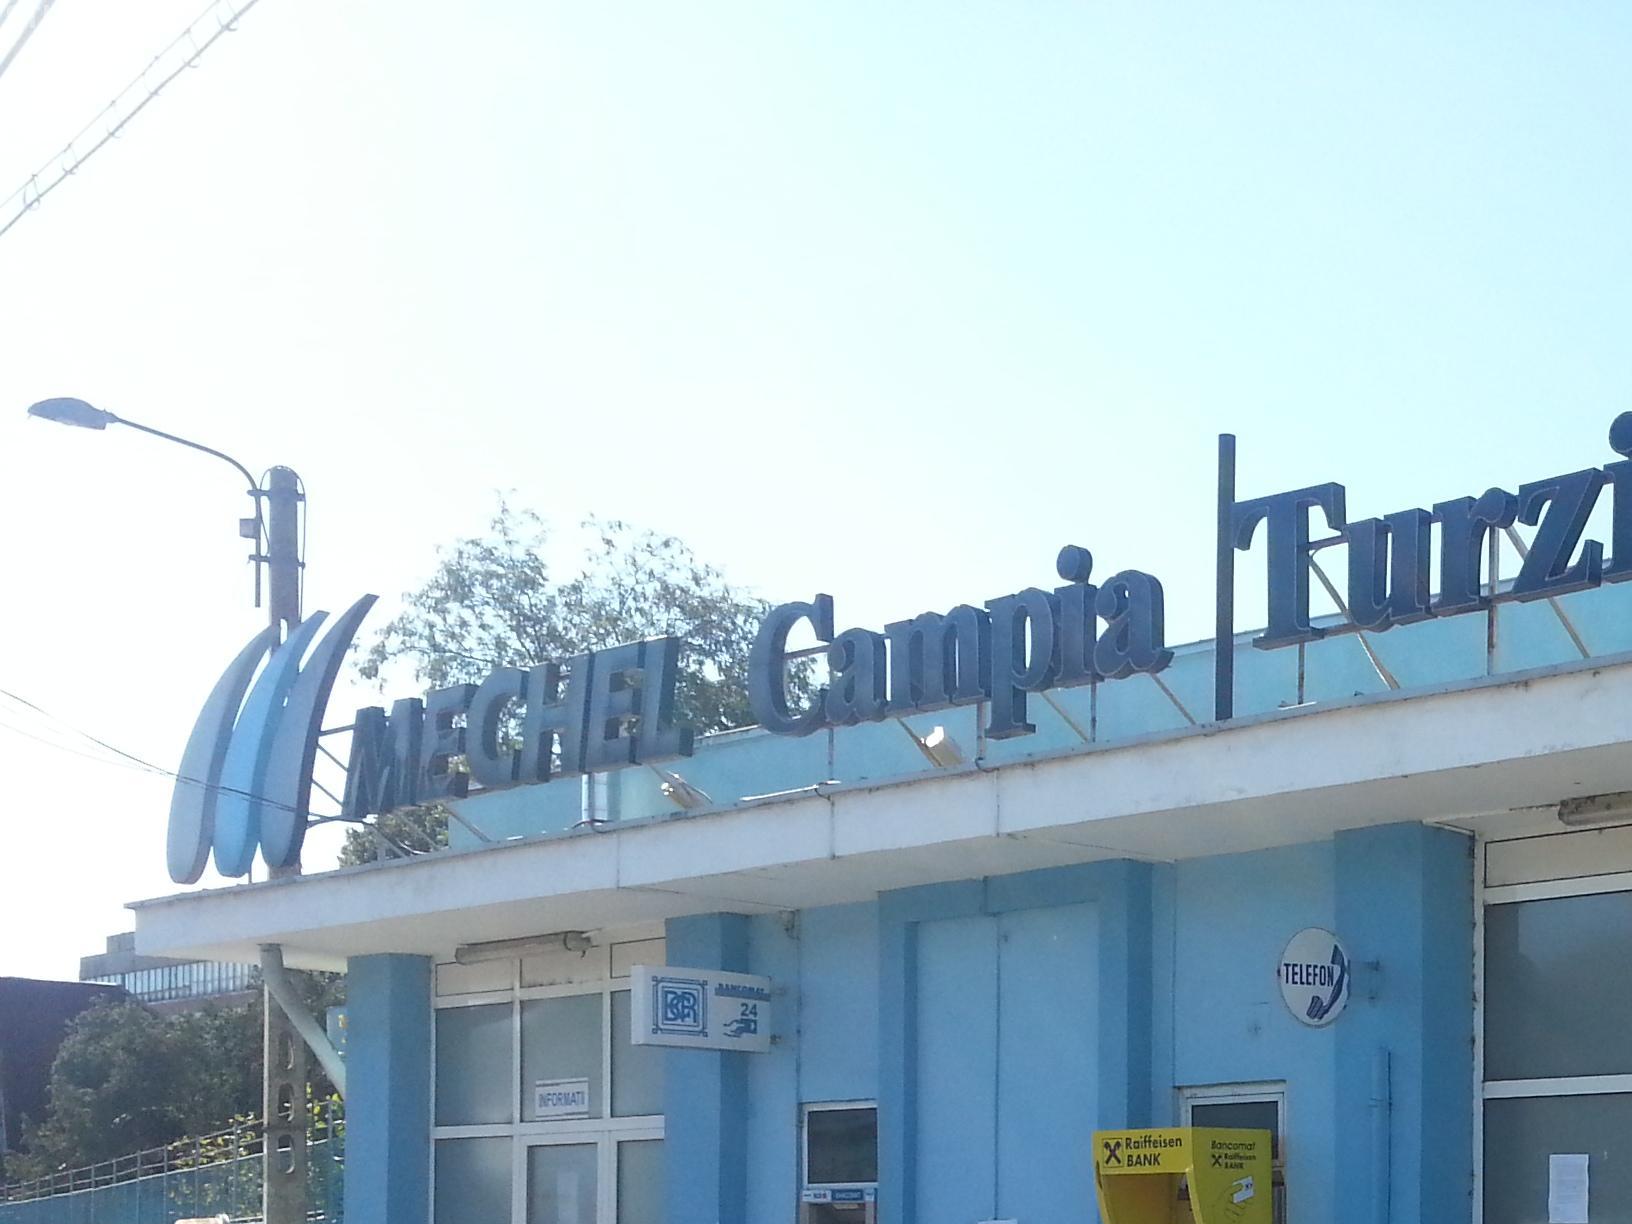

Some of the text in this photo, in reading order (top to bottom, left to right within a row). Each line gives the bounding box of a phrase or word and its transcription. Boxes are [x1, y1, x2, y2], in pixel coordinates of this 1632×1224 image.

[340, 634, 695, 818] MECHEL
[748, 544, 1176, 740] Campia
[1283, 963, 1335, 987] TELEFON
[740, 1002, 758, 1017] 24
[1125, 1134, 1183, 1150] Raiffeisen
[1211, 1140, 1256, 1150] Bancomat
[1126, 1153, 1161, 1167] BANK
